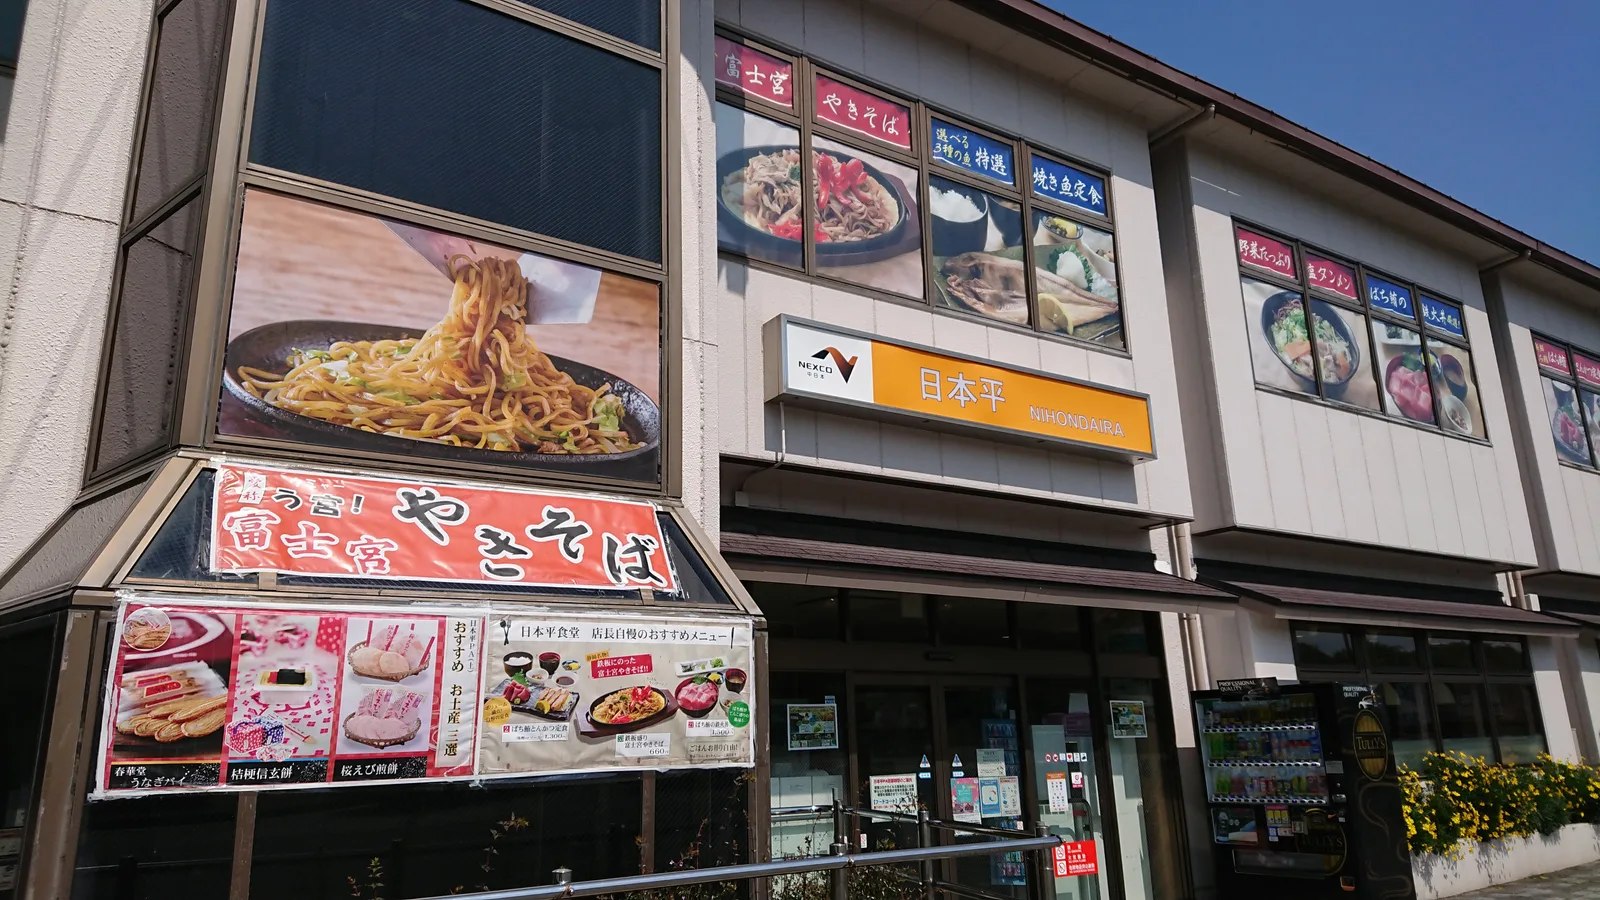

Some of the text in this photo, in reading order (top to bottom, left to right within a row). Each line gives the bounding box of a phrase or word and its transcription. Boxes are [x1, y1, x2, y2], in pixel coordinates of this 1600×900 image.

[725, 53, 790, 95] 富士宮
[823, 93, 900, 136] やきそば
[936, 127, 969, 149] 選べる
[975, 146, 1008, 176] 特選
[1033, 166, 1104, 206] 焼き魚定食
[798, 360, 833, 374] NEXCO
[806, 371, 825, 380] 中日本
[919, 366, 1006, 413] 日本平
[1030, 404, 1126, 438] NIHONDAIRA
[223, 507, 398, 576] 富士宮
[393, 487, 668, 586] やきそば
[521, 626, 728, 641] 日本平食堂 店長自慢のおすすめメニュー
[444, 621, 467, 757] おすすめ お土産 三選
[114, 766, 147, 777] 春華堂
[130, 776, 187, 788] うなぎパイ
[230, 767, 293, 781] 桔梗信玄餅
[341, 763, 399, 777] 桜えび煎餅
